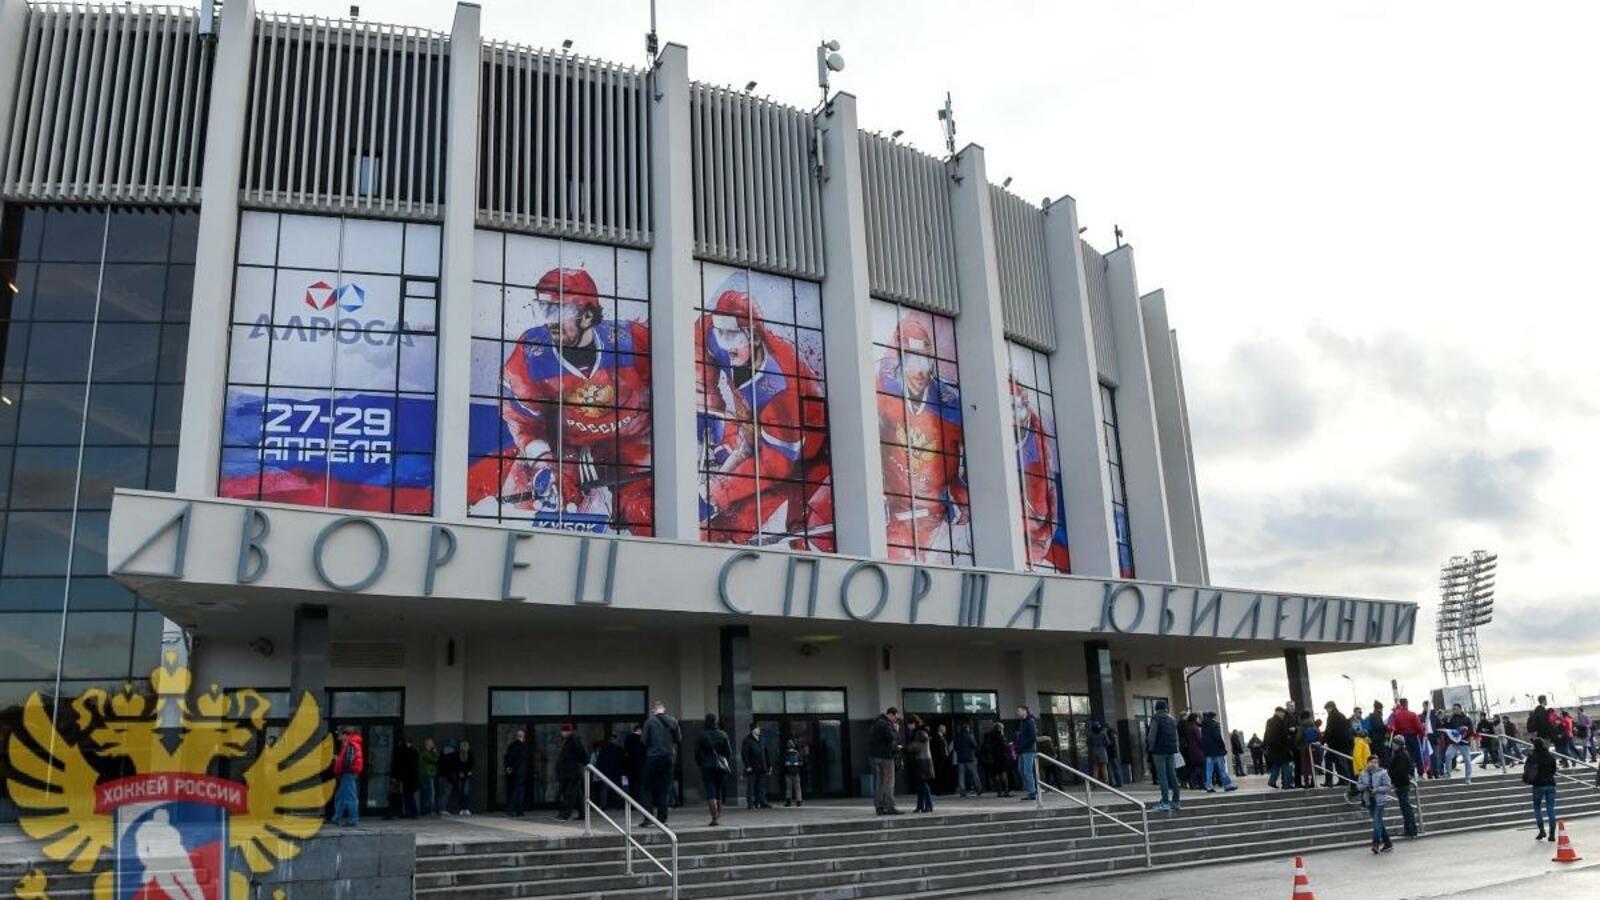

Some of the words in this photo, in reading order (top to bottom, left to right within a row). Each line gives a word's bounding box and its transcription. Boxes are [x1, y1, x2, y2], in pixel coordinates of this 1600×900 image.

[248, 313, 416, 348] АЛРОСА
[260, 403, 392, 437] 27-29
[258, 437, 392, 464] АПРЕЛЯ
[112, 502, 618, 604] ДВОРЕЦ
[718, 550, 1045, 629] СПОРТА
[1096, 582, 1419, 645] ЮБИЛЕЙНЫЙ
